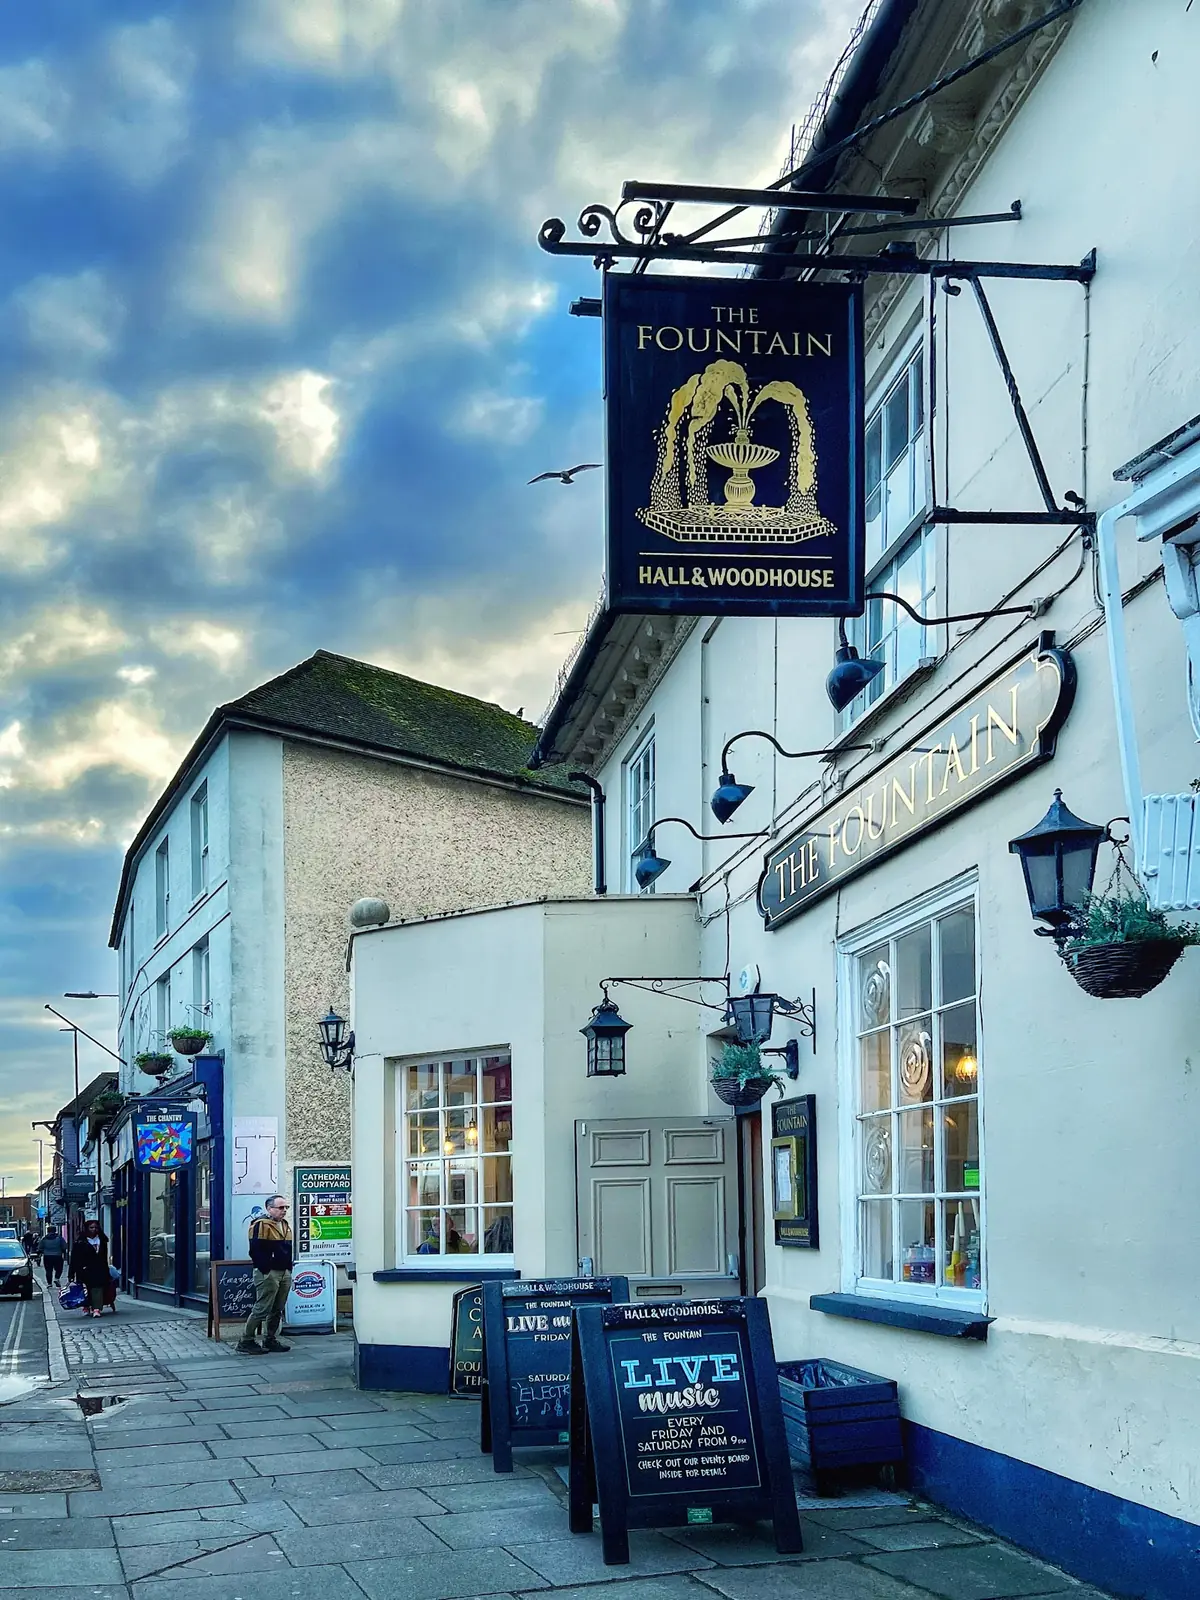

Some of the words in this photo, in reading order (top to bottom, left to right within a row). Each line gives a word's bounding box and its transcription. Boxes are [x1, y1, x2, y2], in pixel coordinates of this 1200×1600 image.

[711, 306, 759, 324] THE
[637, 325, 832, 357] FOUNTAIN
[639, 566, 835, 588] HALL&WOODHOUSE
[774, 835, 820, 903] THE
[828, 682, 1021, 869] FOUNTAIN
[787, 1106, 797, 1115] THE
[158, 1114, 183, 1122] CHANTRY
[776, 1115, 808, 1133] FOUNTAIN
[301, 1173, 350, 1181] CATHEDRAL
[301, 1207, 308, 1215] 2
[301, 1219, 308, 1227] 3
[301, 1231, 308, 1239] 4
[301, 1243, 308, 1251] 5
[223, 1289, 254, 1302] Coffee
[221, 1302, 239, 1312] this
[525, 1302, 538, 1310] THE
[540, 1300, 571, 1308] FOUNTAIN
[624, 1305, 724, 1320] HALL&WOODHOUSE
[507, 1315, 549, 1332] LIVE
[534, 1333, 571, 1342] FRIDAY
[641, 1332, 658, 1342] THE
[663, 1329, 702, 1341] FOUNTAIN
[620, 1353, 740, 1389] LIVE
[519, 1384, 570, 1402] ELECTR
[638, 1383, 721, 1414] music
[667, 1416, 704, 1428] EVERY
[651, 1428, 693, 1440] FRIDAY
[700, 1425, 725, 1436] AND
[637, 1439, 693, 1452] SATURDAY
[697, 1436, 728, 1448] FROM
[637, 1459, 662, 1470] CHECK
[665, 1458, 682, 1468] OUT
[683, 1457, 699, 1466] OUR
[701, 1454, 726, 1465] EVENTS
[728, 1454, 750, 1463] BOARD
[659, 1469, 683, 1480] INSIDE
[685, 1468, 700, 1477] FOR
[700, 1467, 727, 1477] DETAILS
